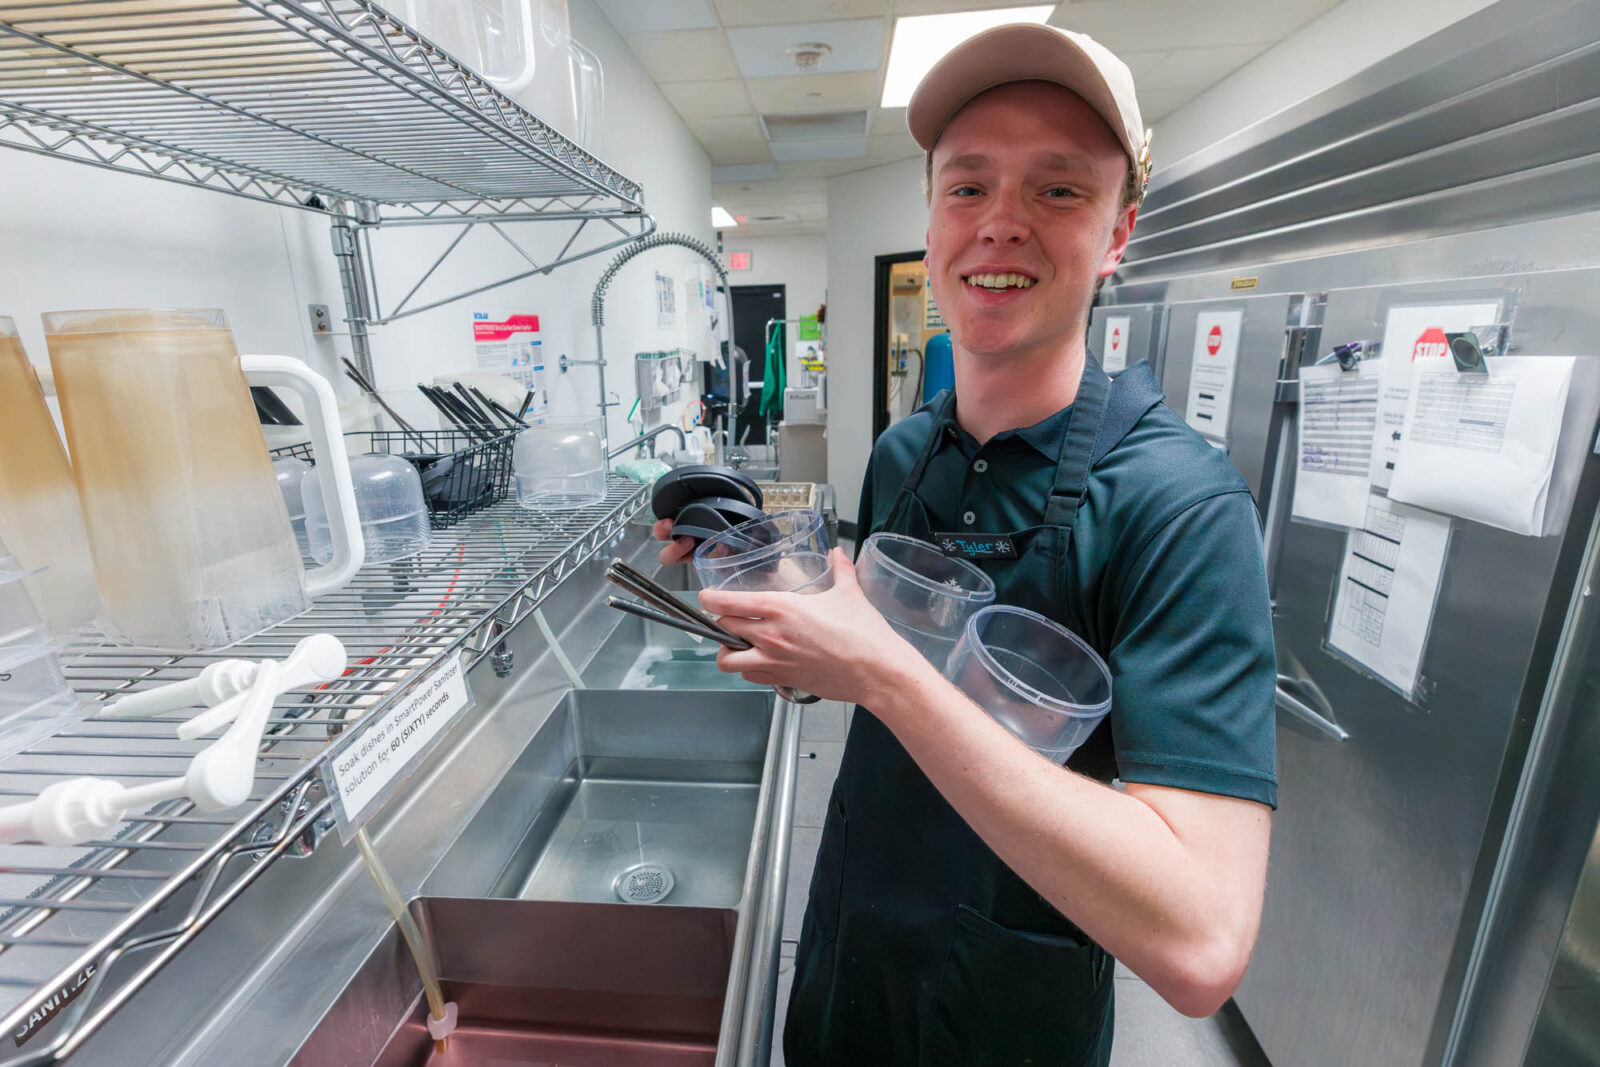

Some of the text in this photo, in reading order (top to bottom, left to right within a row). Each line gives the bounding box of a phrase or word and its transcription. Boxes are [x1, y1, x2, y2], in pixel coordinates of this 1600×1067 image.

[1415, 342, 1446, 358] STOP
[955, 540, 993, 556] Tyler
[338, 664, 458, 777] Soak dishes in SmartPower Sanitizer
[344, 691, 450, 796] solution for 60 (SIXTY) seconds
